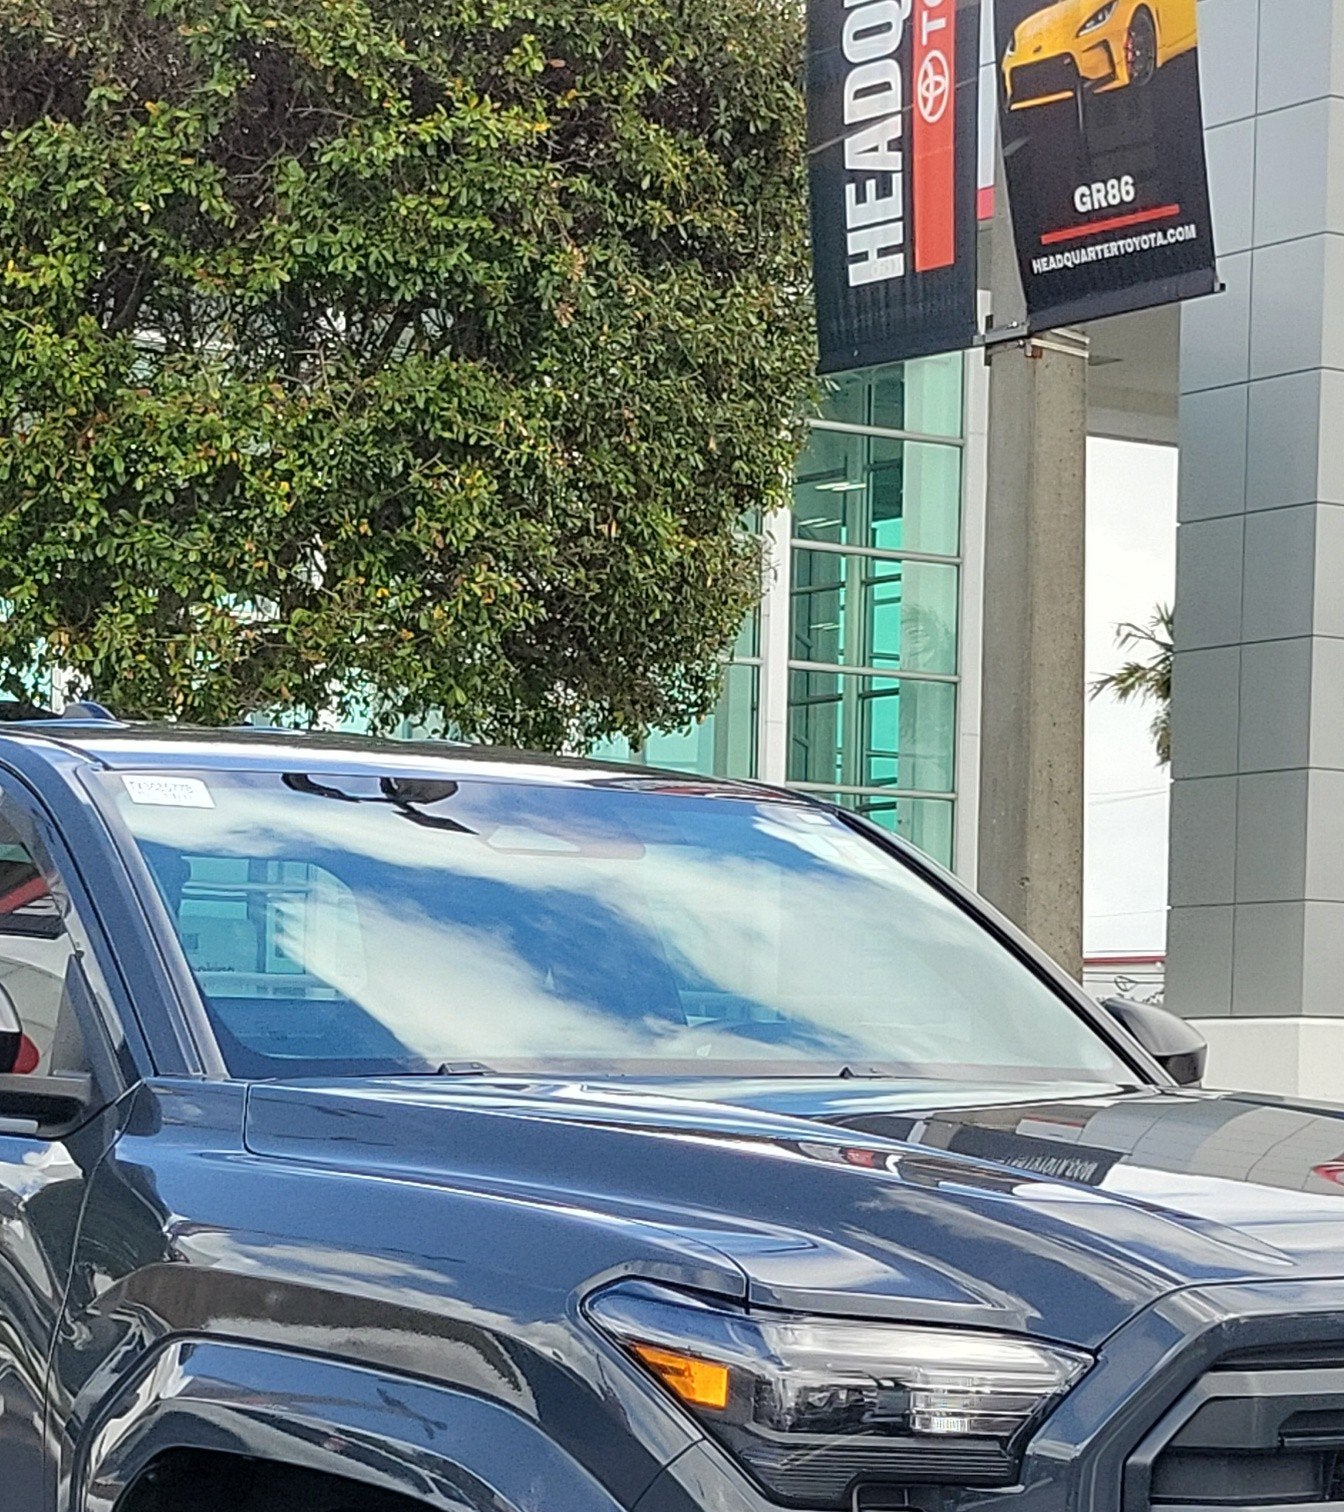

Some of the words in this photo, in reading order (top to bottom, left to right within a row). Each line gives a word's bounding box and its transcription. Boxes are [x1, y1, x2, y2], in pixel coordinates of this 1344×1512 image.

[921, 0, 946, 46] T
[843, 0, 912, 287] HEADQ
[1074, 175, 1135, 213] GR86
[1031, 224, 1197, 274] HEADQUARTERTOYOTA.COM
